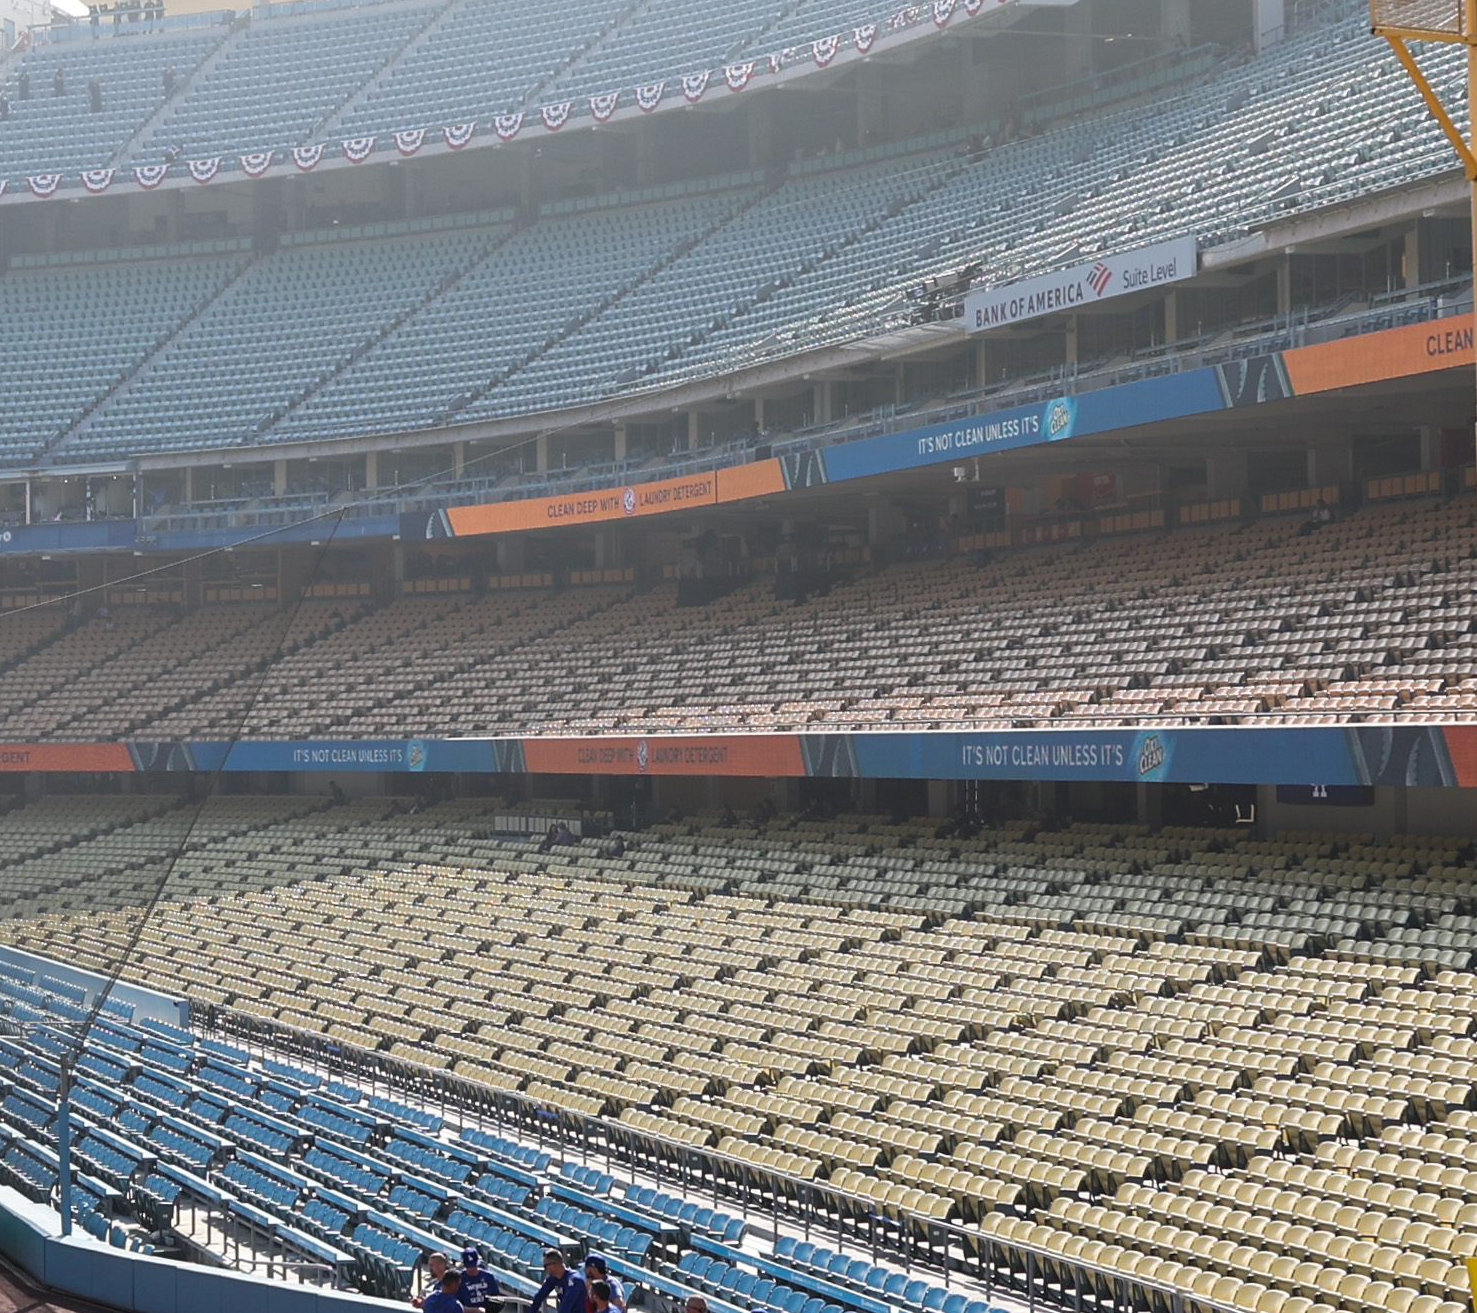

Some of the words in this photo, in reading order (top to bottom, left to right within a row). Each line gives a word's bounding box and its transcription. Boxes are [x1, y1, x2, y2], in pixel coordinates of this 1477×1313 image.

[1123, 270, 1147, 289] Suite
[1150, 257, 1176, 281] Level
[976, 302, 1007, 327] BANK
[1010, 298, 1024, 318] OF
[1028, 282, 1083, 314] AMERICA
[1426, 327, 1473, 356] CLEAN
[919, 437, 934, 454] IT'S
[936, 432, 952, 450] NOT
[955, 427, 984, 447] CLEAN
[985, 419, 1019, 441] UNLESS
[1021, 415, 1039, 434] IT'S
[1050, 411, 1069, 434] CLEAN
[548, 504, 574, 518] CLEAN
[577, 501, 598, 515] DEEP
[600, 498, 619, 511] WITH
[640, 490, 670, 506] LAUNDRY
[674, 481, 711, 500] DETERGENT
[294, 750, 309, 762] IT'S
[312, 750, 329, 762] NOT
[331, 750, 356, 762] CLEAN
[359, 750, 388, 762] UNLESS
[390, 749, 402, 762] IT'S
[962, 746, 983, 766] IT'S
[986, 746, 1008, 766] NOT
[1012, 746, 1049, 766] CLEAN
[1053, 745, 1096, 766] UNLESS
[1101, 745, 1123, 766] IT'S
[1139, 747, 1164, 775] CLEAN
